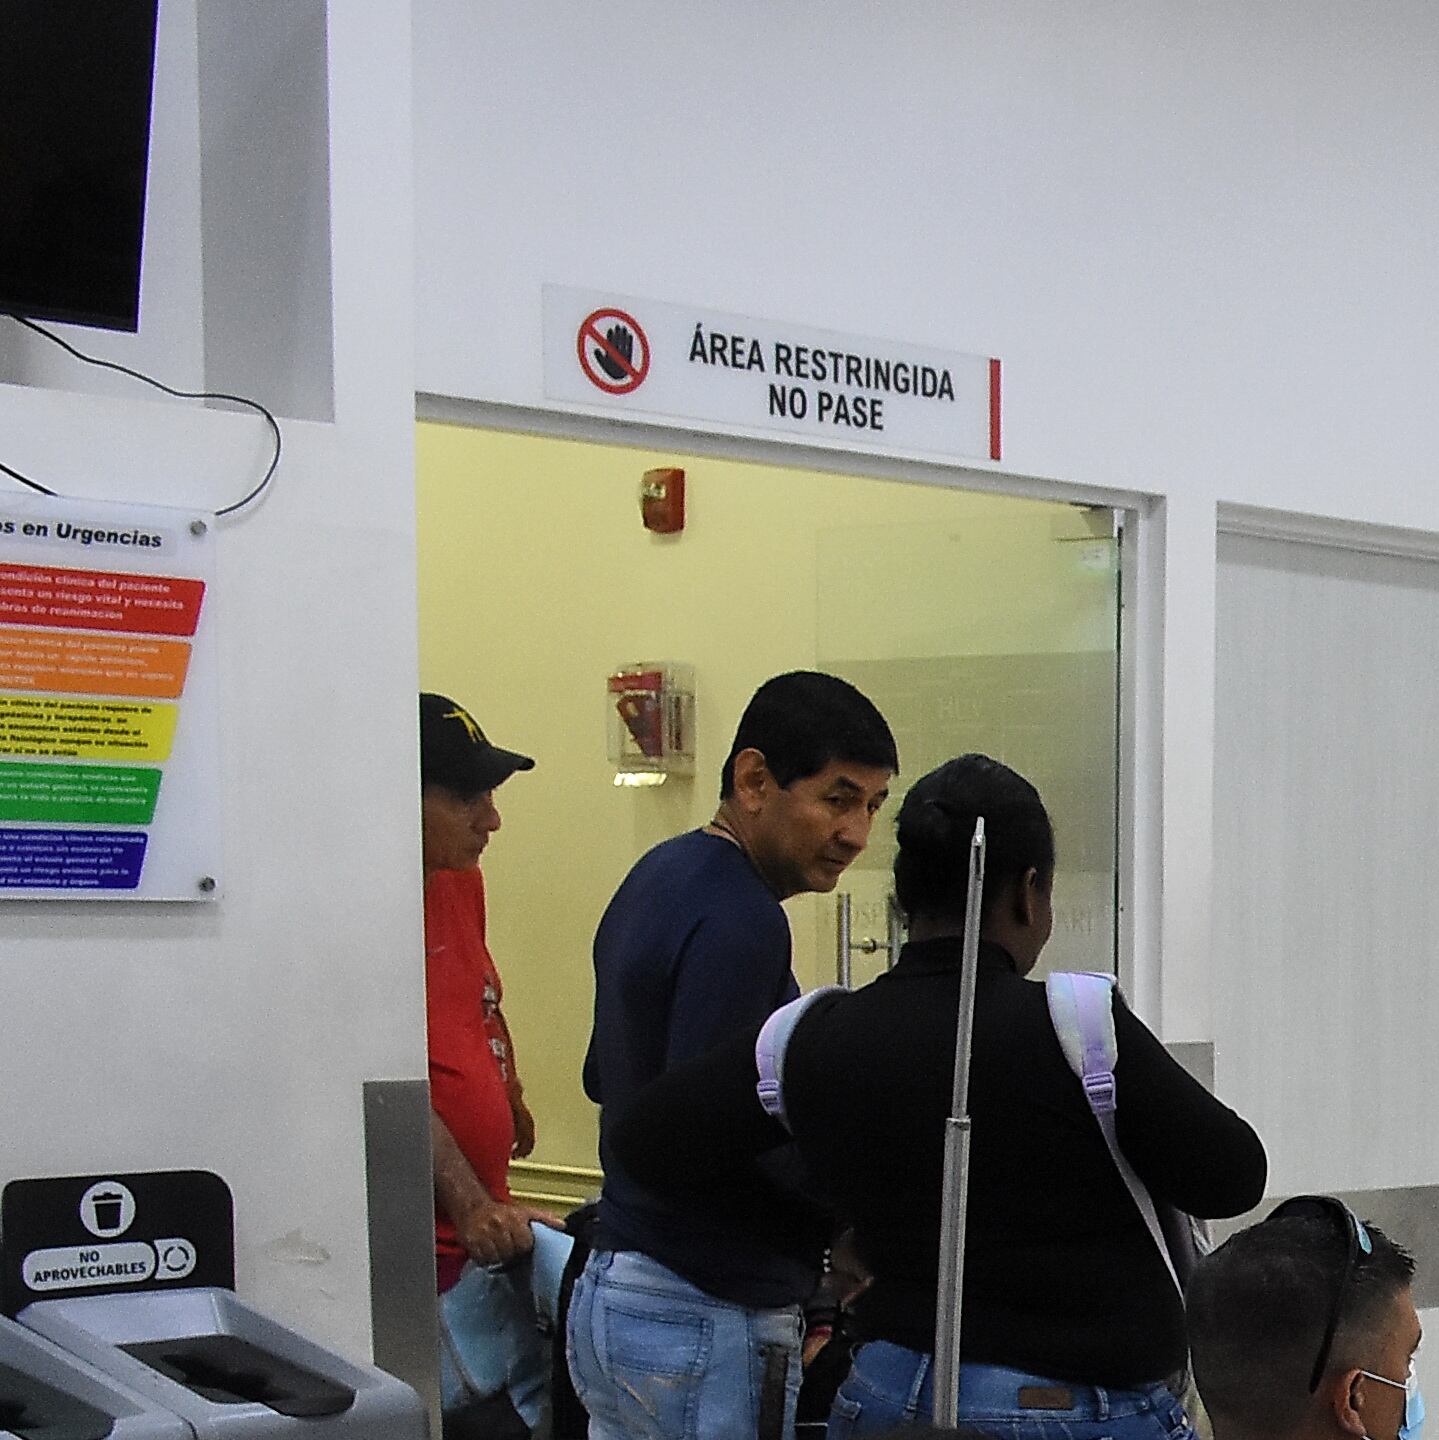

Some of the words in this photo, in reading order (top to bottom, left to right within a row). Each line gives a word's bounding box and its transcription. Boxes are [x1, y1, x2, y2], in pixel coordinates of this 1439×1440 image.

[689, 321, 765, 374] ÁREA
[775, 341, 956, 402] RESTRINGIDA
[768, 384, 807, 419] NO
[817, 391, 885, 432] PASE
[22, 523, 49, 538] en
[56, 522, 163, 548] Urgencias
[79, 1250, 100, 1263] NO
[33, 1261, 147, 1283] APROVECHABLES
